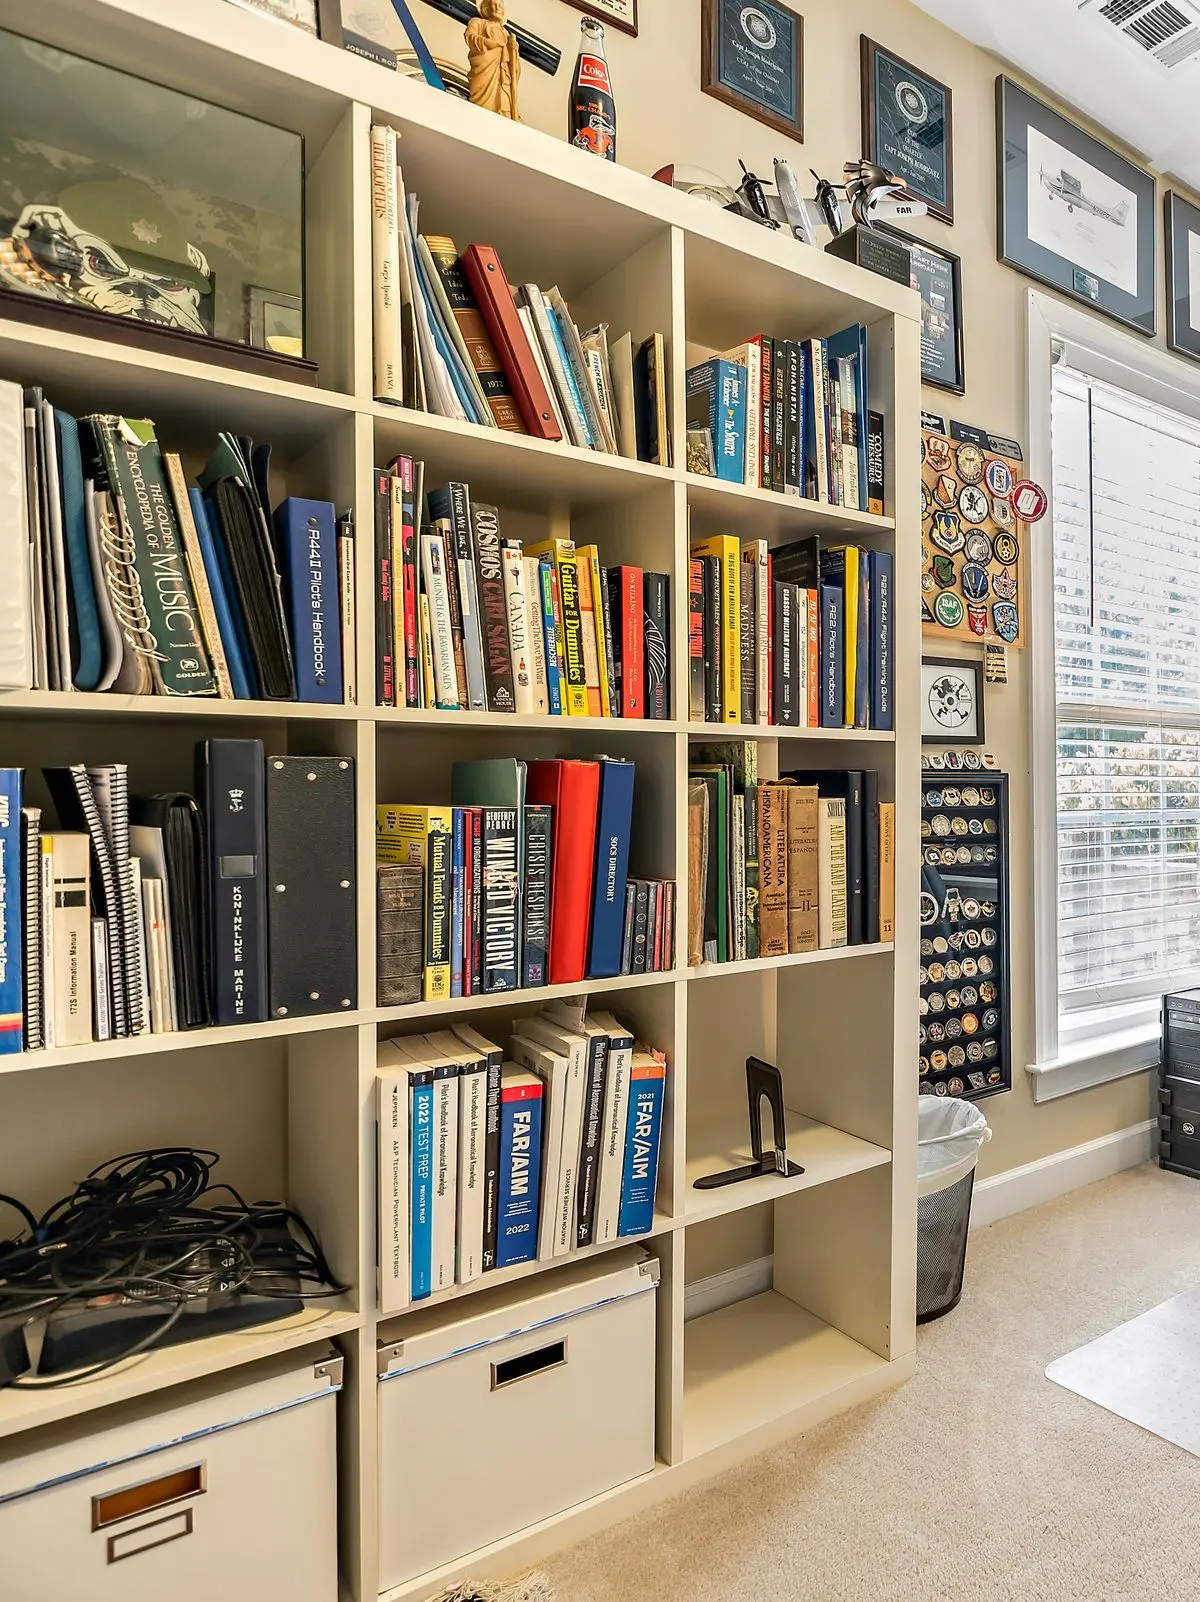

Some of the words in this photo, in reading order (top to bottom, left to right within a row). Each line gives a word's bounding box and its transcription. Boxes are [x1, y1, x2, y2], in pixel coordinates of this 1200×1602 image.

[732, 40, 744, 50] Capt
[745, 47, 760, 60] Joseph
[761, 56, 784, 73] Rodriguez
[583, 63, 606, 79] Coke
[884, 144, 896, 156] CAPT
[897, 150, 914, 166] JOSEPH
[914, 160, 940, 179] RODRIGUEZ
[903, 144, 922, 160] QUARTER
[373, 141, 387, 219] HELICOPTERS
[723, 376, 732, 407] Michener
[732, 378, 741, 399] James
[725, 420, 734, 430] The
[724, 430, 739, 457] Source
[874, 435, 882, 486] COMEDY
[127, 451, 154, 531] ENCYCLOPEDIA
[147, 532, 161, 549] OF
[150, 483, 163, 501] THE
[155, 503, 175, 550] GOLDEN
[476, 510, 502, 580] COSMOS
[150, 552, 195, 632] MUSIC
[561, 564, 576, 609] Guitar
[629, 573, 636, 583] ON
[433, 577, 443, 611] MUNICH
[482, 582, 504, 620] CARL
[782, 589, 790, 615] CLASSIC
[437, 620, 446, 633] THE
[508, 592, 525, 652] CANADA
[531, 602, 540, 626] Getting
[533, 626, 541, 639] The
[740, 604, 749, 661] MADNESS
[760, 612, 768, 657] GUITARIST
[440, 636, 450, 671] BAVARIAN
[486, 624, 509, 676] SAGAN
[534, 639, 542, 655] Love
[547, 627, 556, 668] BESCHERELLE
[564, 618, 581, 682] Dummies
[535, 655, 543, 668] You
[443, 672, 452, 689] ALPS
[536, 668, 545, 685] Want
[829, 662, 837, 707] Handbook
[486, 811, 516, 821] GEOFFREY
[486, 821, 515, 830] PERRET
[474, 838, 481, 846] IN
[609, 837, 618, 856] SOCS
[762, 790, 772, 888] HISPANOAMERICANA
[830, 825, 844, 842] AND
[434, 836, 446, 867] Mutual
[528, 834, 546, 876] CRISIS
[777, 829, 785, 887] LITERATURA
[831, 844, 845, 860] THE
[473, 847, 481, 894] ORGANIZATIONS
[486, 836, 517, 901] WINGED
[606, 857, 617, 902] DIRECTORY
[831, 864, 845, 886] BAND
[433, 870, 446, 903] Funds
[526, 881, 546, 942] RESPONSE
[832, 889, 846, 918] PLAYED
[432, 911, 443, 959] Dummies
[485, 906, 516, 971] VICTORY
[832, 921, 846, 932] ON
[234, 969, 244, 1015] MARINE
[597, 1042, 606, 1057] Pilot's
[616, 1054, 624, 1069] Pilot's
[489, 1065, 500, 1088] Airplane
[594, 1058, 603, 1082] Handbook
[613, 1070, 622, 1092] Handbook
[471, 1078, 479, 1095] Pilot's
[488, 1089, 499, 1105] Flying
[417, 1096, 429, 1124] 2022
[441, 1101, 449, 1126] Handbook
[590, 1089, 601, 1119] Aeronautical
[611, 1099, 620, 1130] Aeronautical
[487, 1106, 498, 1133] Handbook
[417, 1126, 429, 1151] TEST
[469, 1128, 477, 1160] Aeronautical
[586, 1120, 597, 1148] Knowledge
[608, 1130, 617, 1156] Knowledge
[631, 1101, 653, 1179] FAR/AIM
[439, 1134, 447, 1167] Aeronautical
[511, 1111, 531, 1196] FAR/AIM
[417, 1154, 429, 1178] PREP
[438, 1169, 446, 1197] Knowledge
[505, 1224, 530, 1234] 2022
